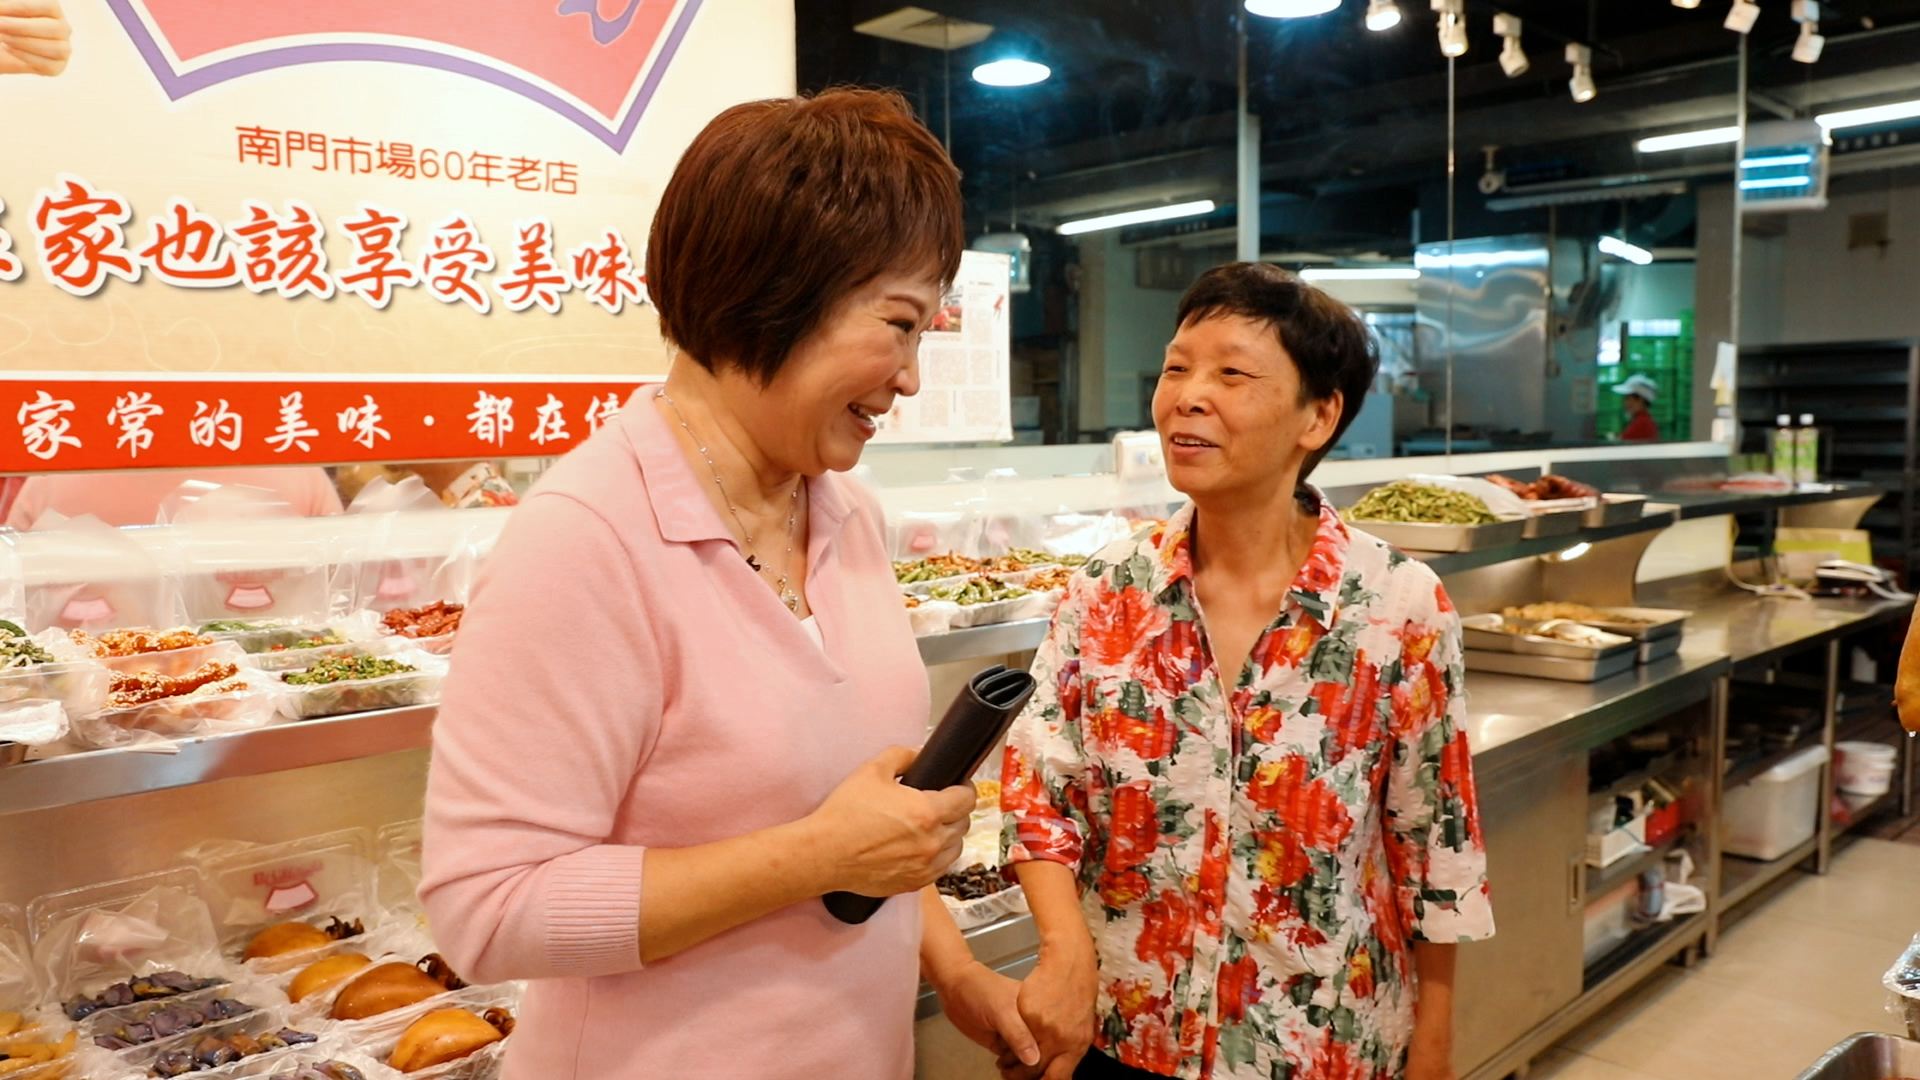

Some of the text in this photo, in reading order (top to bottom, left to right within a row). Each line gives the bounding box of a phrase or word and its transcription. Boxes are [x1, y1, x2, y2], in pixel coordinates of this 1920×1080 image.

[235, 125, 578, 195] 南門市場60年老店
[0, 181, 647, 307] 家也該享受美味
